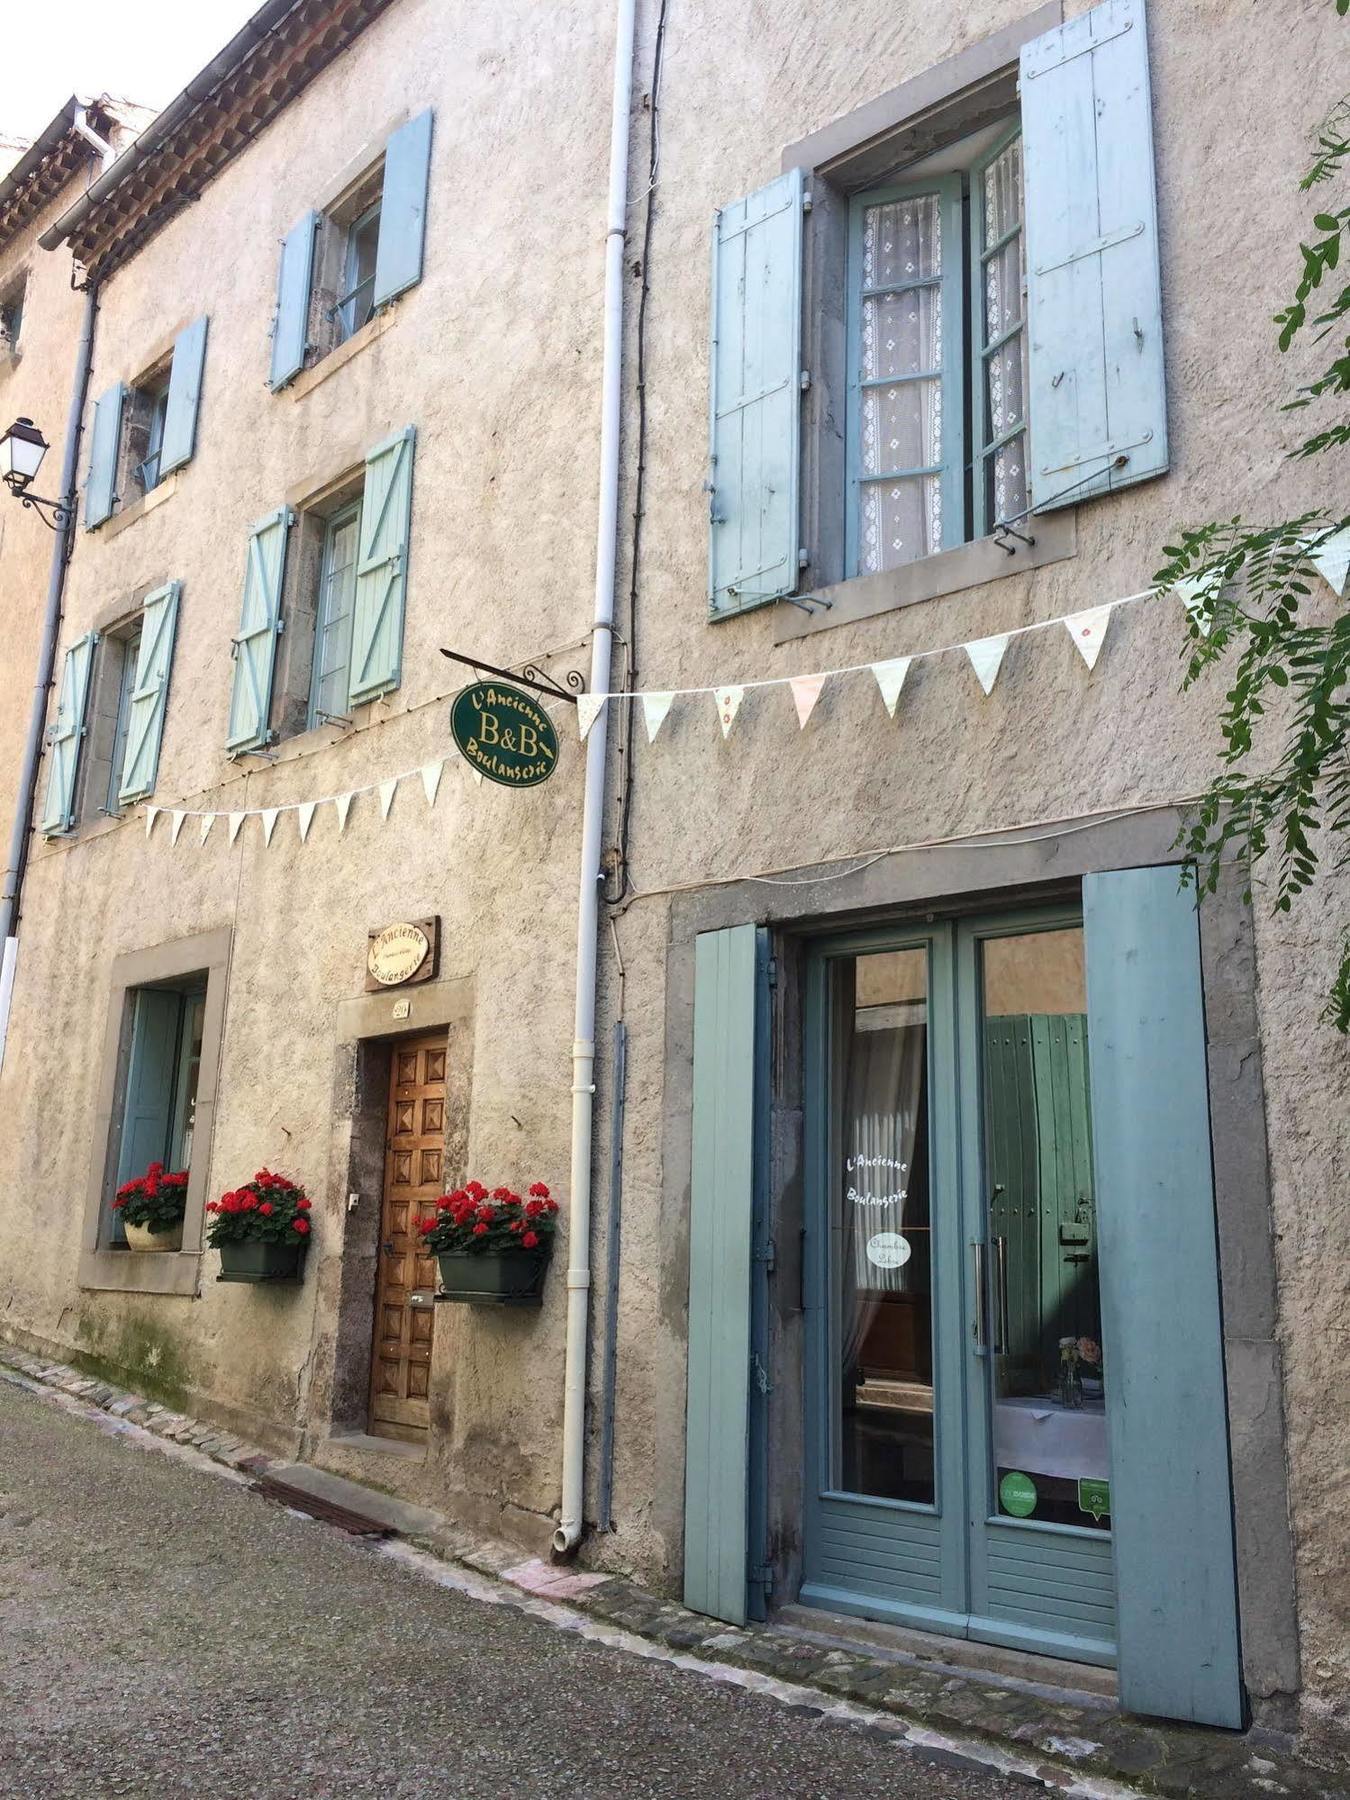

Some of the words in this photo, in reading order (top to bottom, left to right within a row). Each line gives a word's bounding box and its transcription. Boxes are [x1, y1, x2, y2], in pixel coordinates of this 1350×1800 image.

[472, 688, 547, 732] L'Ancienne
[479, 710, 538, 756] B&B
[466, 736, 546, 780] Boulangerie
[846, 1154, 908, 1172] L'Ancienne
[846, 1187, 908, 1208] Boulangerie
